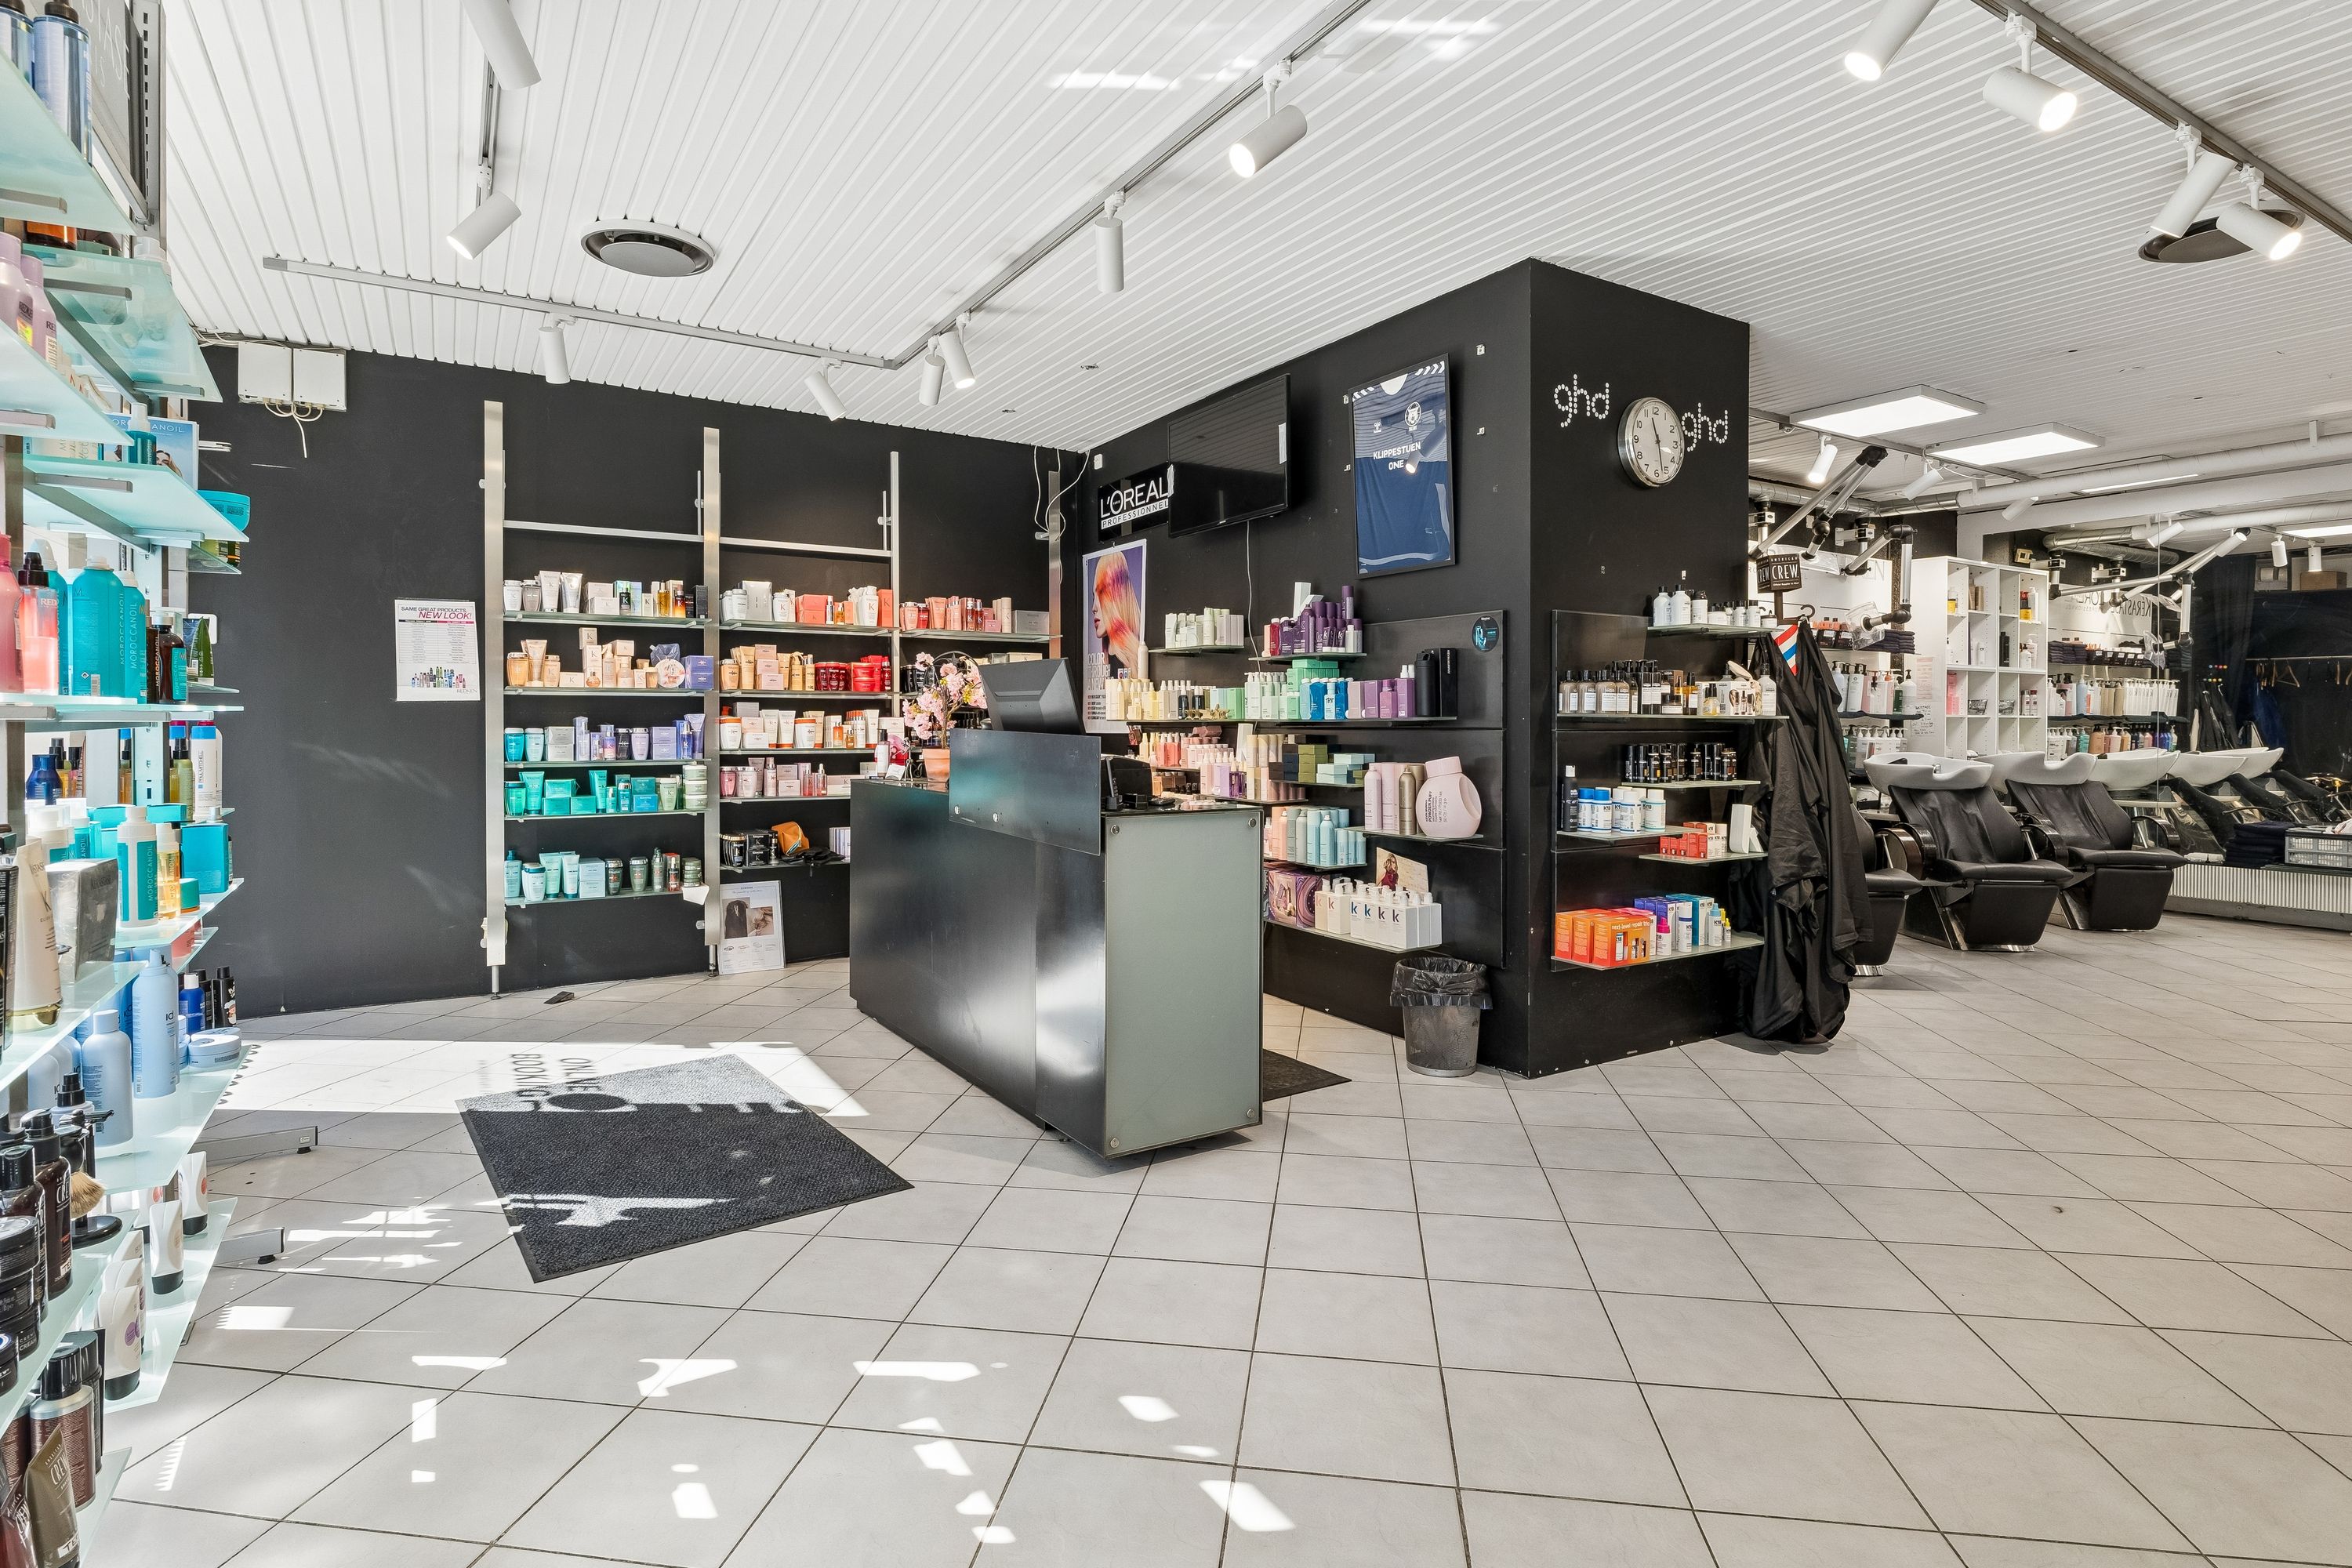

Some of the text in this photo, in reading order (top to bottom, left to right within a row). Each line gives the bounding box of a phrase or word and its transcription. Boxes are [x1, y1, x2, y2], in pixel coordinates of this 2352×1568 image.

[1554, 373, 1610, 427] ghd
[1644, 408, 1649, 418] 11
[1652, 406, 1660, 416] 12
[1664, 412, 1667, 421] 1
[1636, 420, 1642, 429] 10
[1669, 425, 1675, 434] 2
[1682, 402, 1729, 452] ghd
[1634, 434, 1639, 444] 9
[1672, 441, 1679, 449] 3
[1373, 441, 1421, 460] KLIPPESTUEN
[1636, 451, 1643, 459] 8
[1388, 460, 1404, 470] ONE
[1670, 456, 1675, 464] 4
[1644, 463, 1650, 473] 7
[1653, 469, 1660, 477] 6
[1664, 466, 1669, 475] 5
[1102, 499, 1168, 528] PROFESSIONNEL
[1087, 652, 1105, 666] COLOR
[1087, 664, 1111, 678] THROUGH
[1351, 902, 1358, 914] k
[1364, 904, 1371, 916] k
[1378, 907, 1385, 920] k
[1392, 909, 1399, 923] k
[1611, 921, 1631, 931] next-level
[1631, 920, 1643, 929] repair
